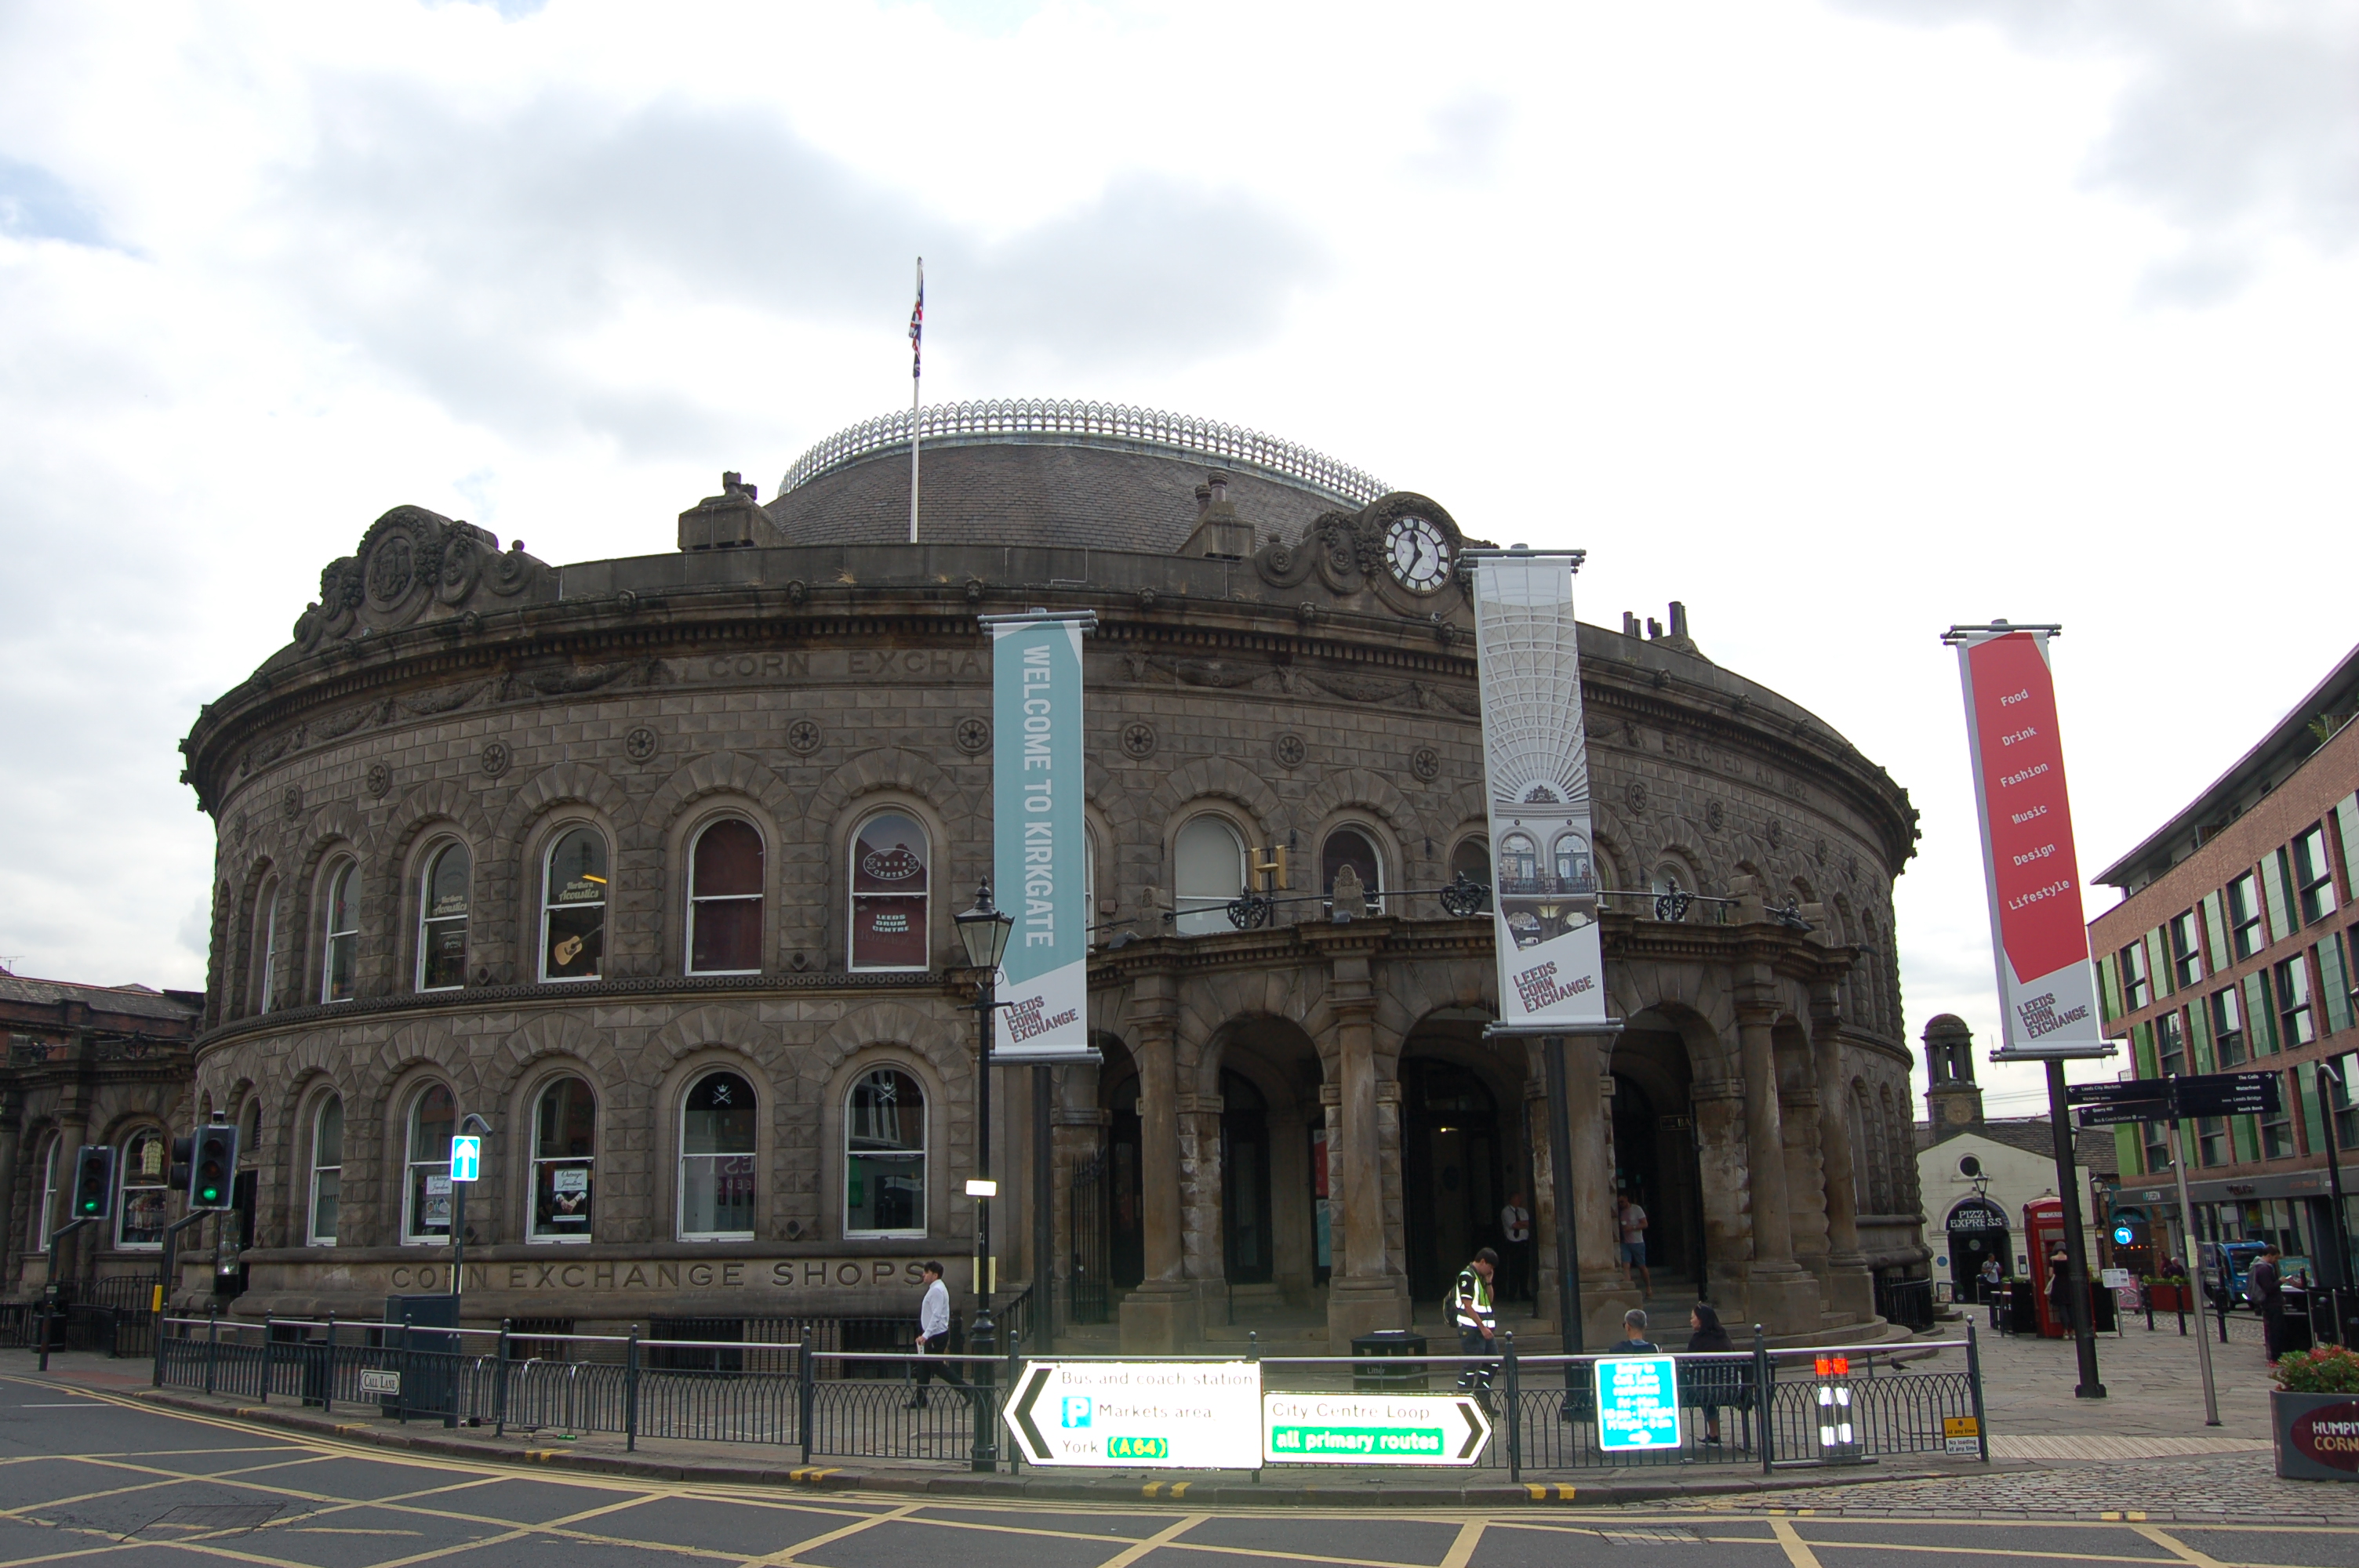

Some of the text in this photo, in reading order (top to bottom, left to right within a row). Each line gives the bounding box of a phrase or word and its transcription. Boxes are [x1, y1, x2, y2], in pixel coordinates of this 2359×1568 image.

[708, 651, 994, 678] CORN EXCHA
[2000, 689, 2030, 707] Food
[2001, 726, 2037, 747] Drink
[2000, 762, 2049, 788] Fashion
[1023, 645, 1053, 948] WELCOME TO KIRKGATE
[2012, 804, 2048, 825] Music
[2013, 843, 2055, 866] Design
[559, 888, 599, 902] Acoustics
[2008, 879, 2070, 911] Lifestyle
[434, 902, 468, 916] Acoustics
[1513, 961, 1558, 988] LEEDS
[1518, 976, 1556, 1000] CORN
[1523, 975, 1595, 1013] EXCHANGE
[1003, 995, 1045, 1020] LEEDS
[2017, 993, 2056, 1017] LEEDS
[1008, 1009, 1042, 1031] CORN
[1012, 1008, 1079, 1044] EXCHANGE
[2023, 1006, 2055, 1028] CORN
[2026, 1004, 2089, 1039] EXCHANGE
[1950, 1218, 2003, 1228] EXPRESS
[1959, 1210, 1992, 1219] PIZZA
[509, 1262, 745, 1288] EXCHANGE
[772, 1261, 925, 1287] SHOPS
[1062, 1372, 1253, 1386] Bus and coach station
[1099, 1404, 1168, 1418] Markets
[1175, 1406, 1212, 1418] area
[1272, 1403, 1430, 1421] City Centre Loop
[1062, 1439, 1098, 1453] York
[1276, 1430, 1439, 1453] all primary routes
[2314, 1436, 2359, 1452] CORN
